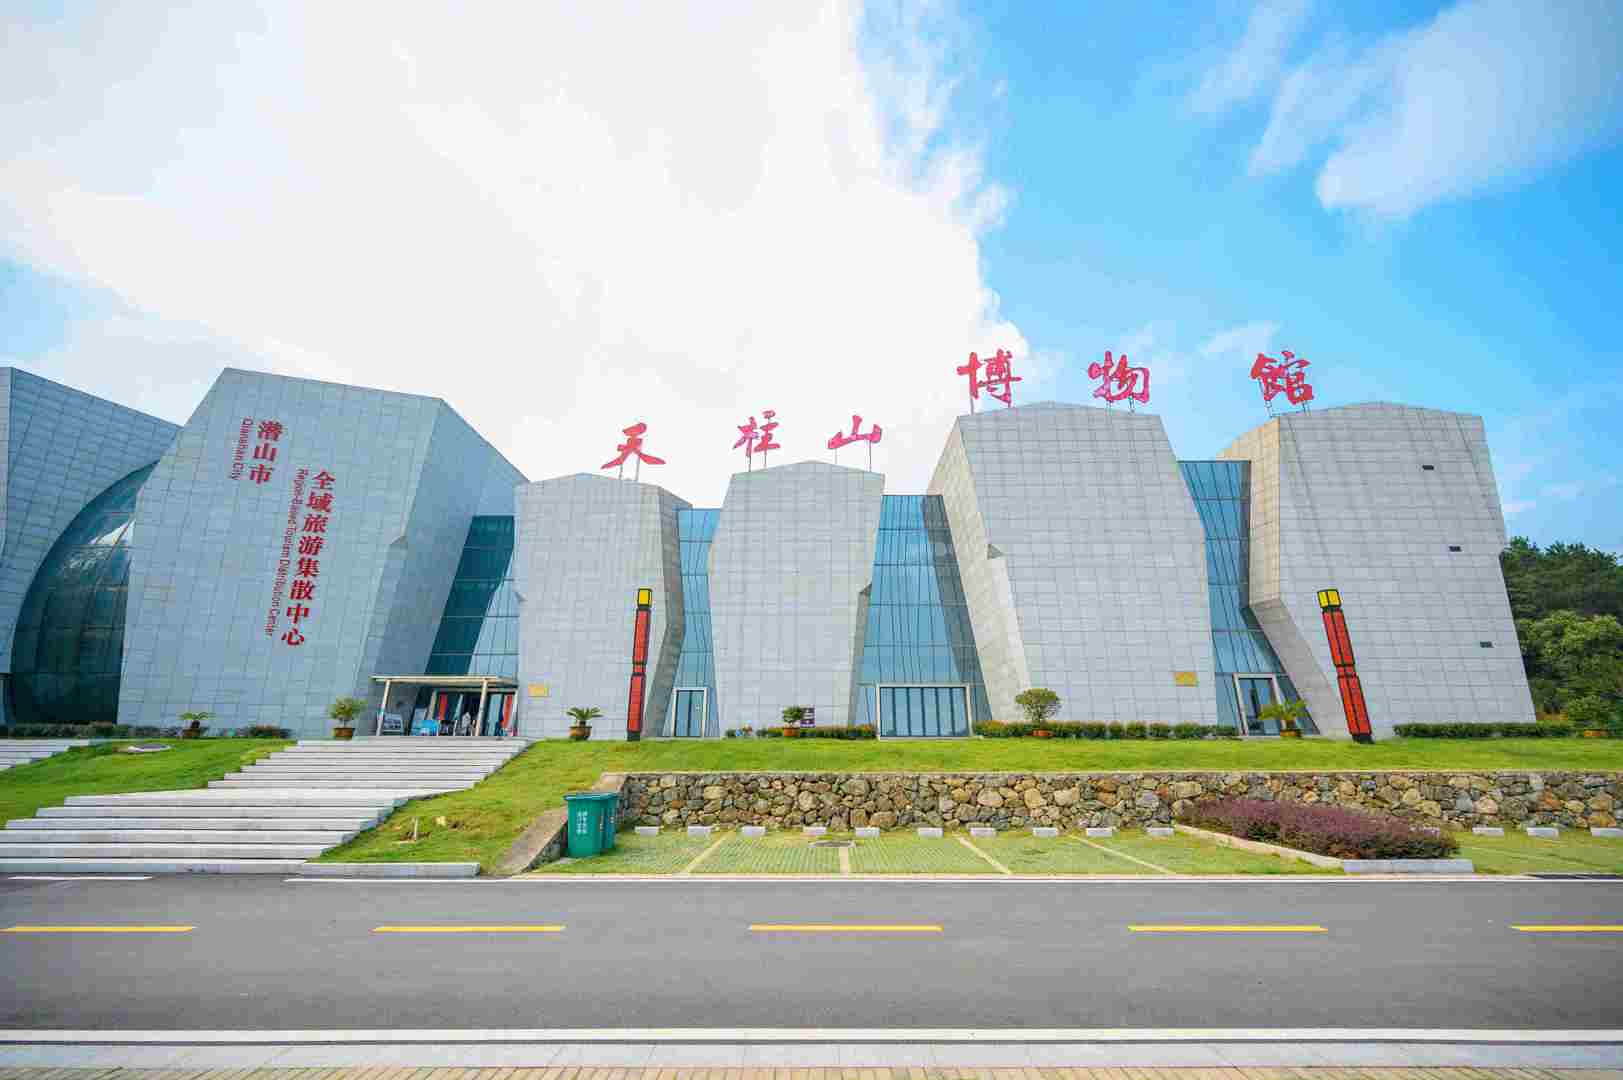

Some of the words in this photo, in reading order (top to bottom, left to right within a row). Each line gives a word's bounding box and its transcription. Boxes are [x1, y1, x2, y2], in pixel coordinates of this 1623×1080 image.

[249, 419, 284, 485] 潜山市
[281, 470, 336, 646] 全域旅游集散中心
